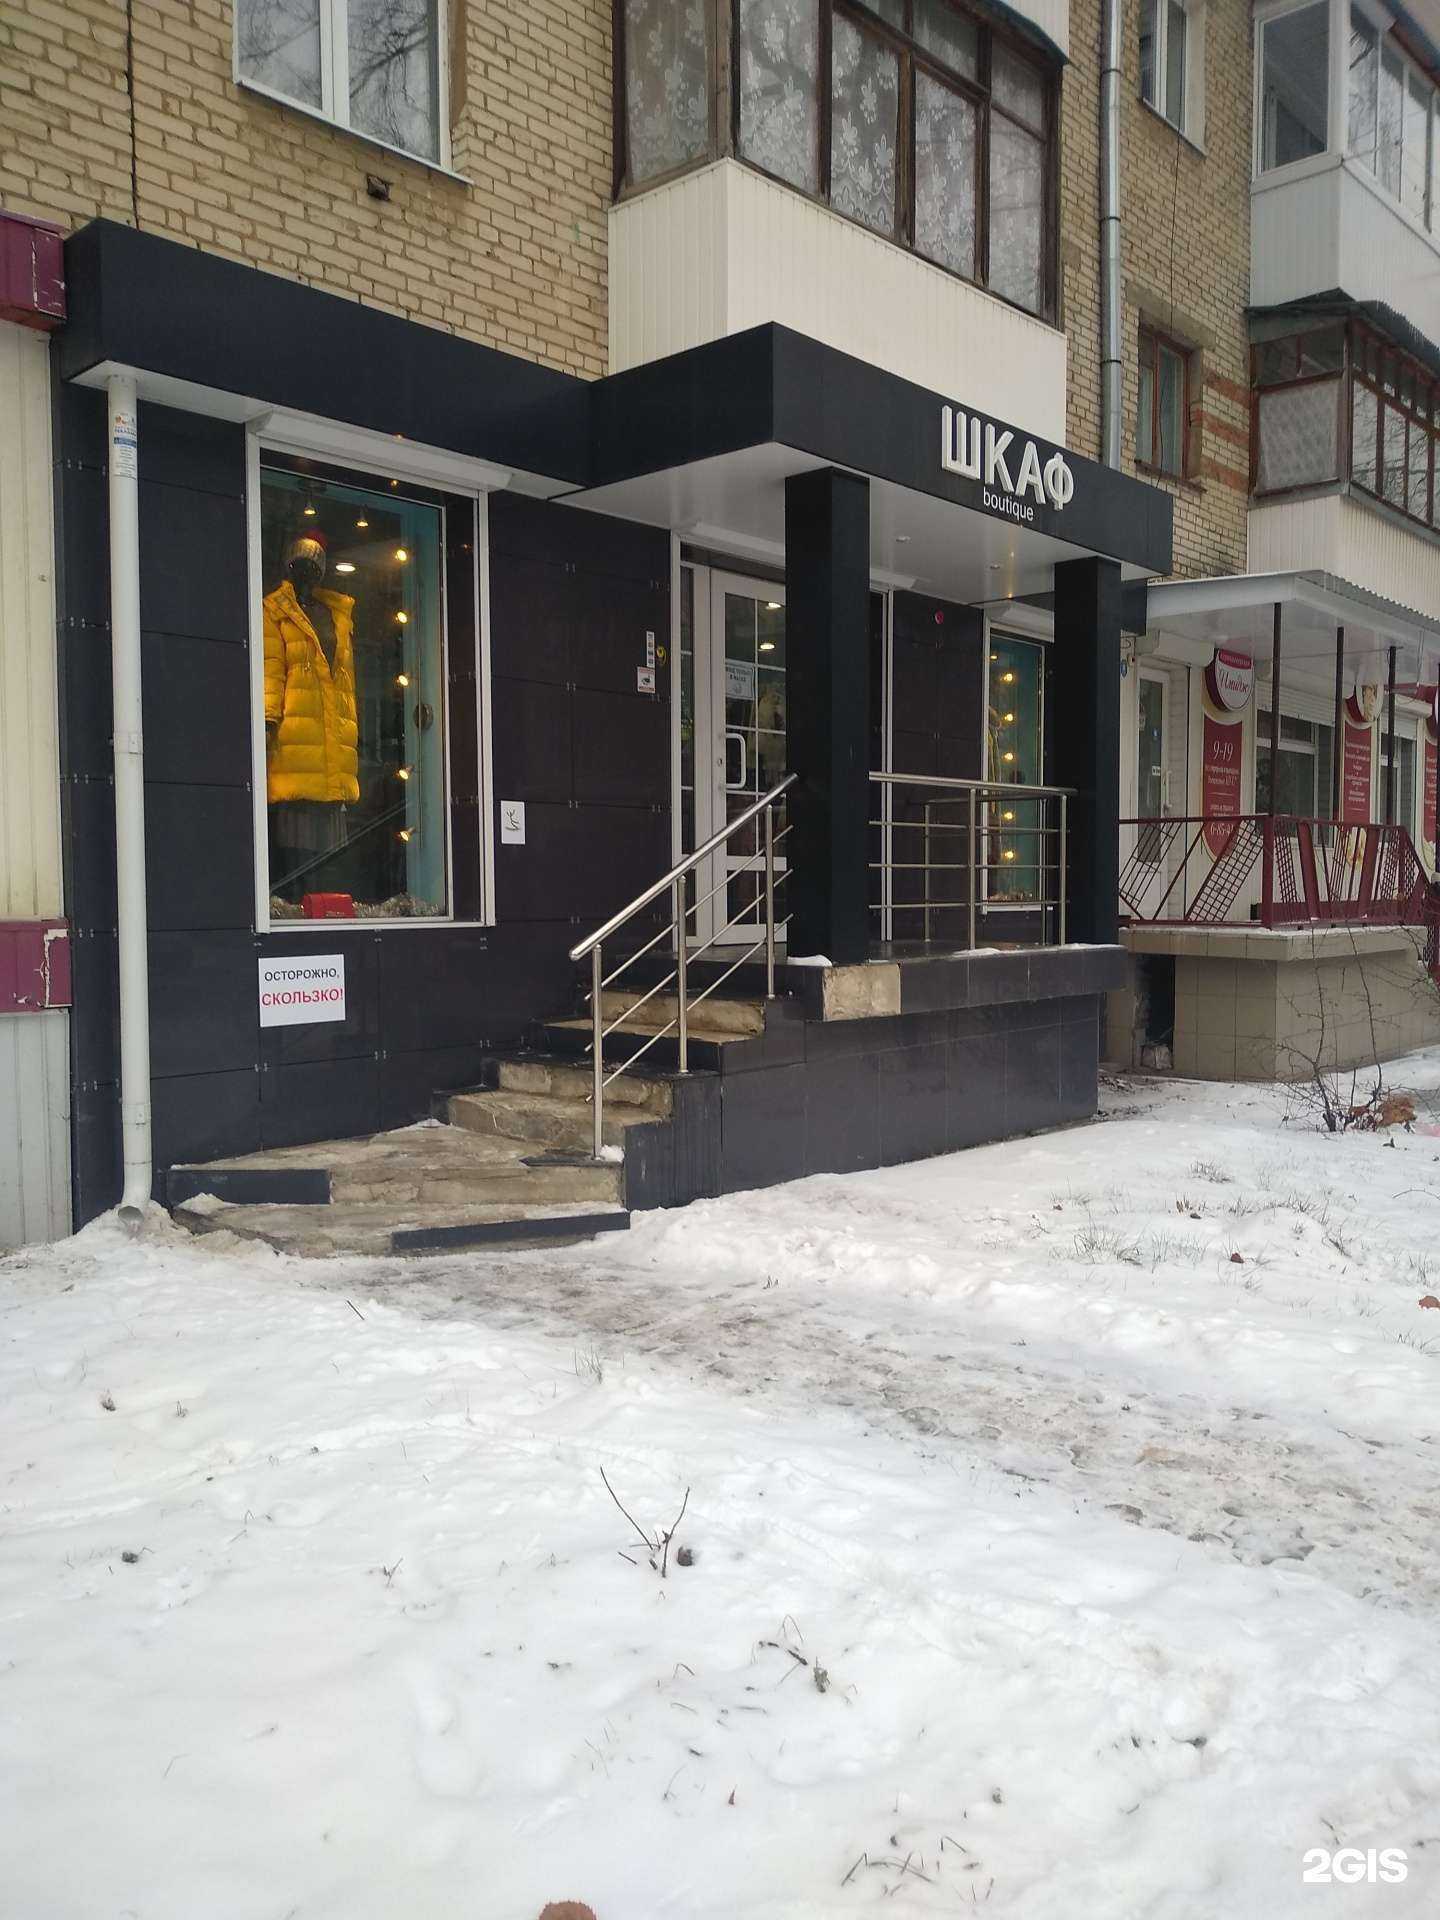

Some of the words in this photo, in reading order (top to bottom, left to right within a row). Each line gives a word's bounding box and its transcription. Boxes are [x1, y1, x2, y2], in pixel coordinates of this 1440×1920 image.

[941, 404, 1074, 511] ШКАФ
[983, 486, 1034, 522] boutique
[1213, 740, 1233, 761] 9-19
[264, 967, 340, 982] ОСТОРОЖНО,
[261, 988, 344, 1006] СКОЛЬЗКО!
